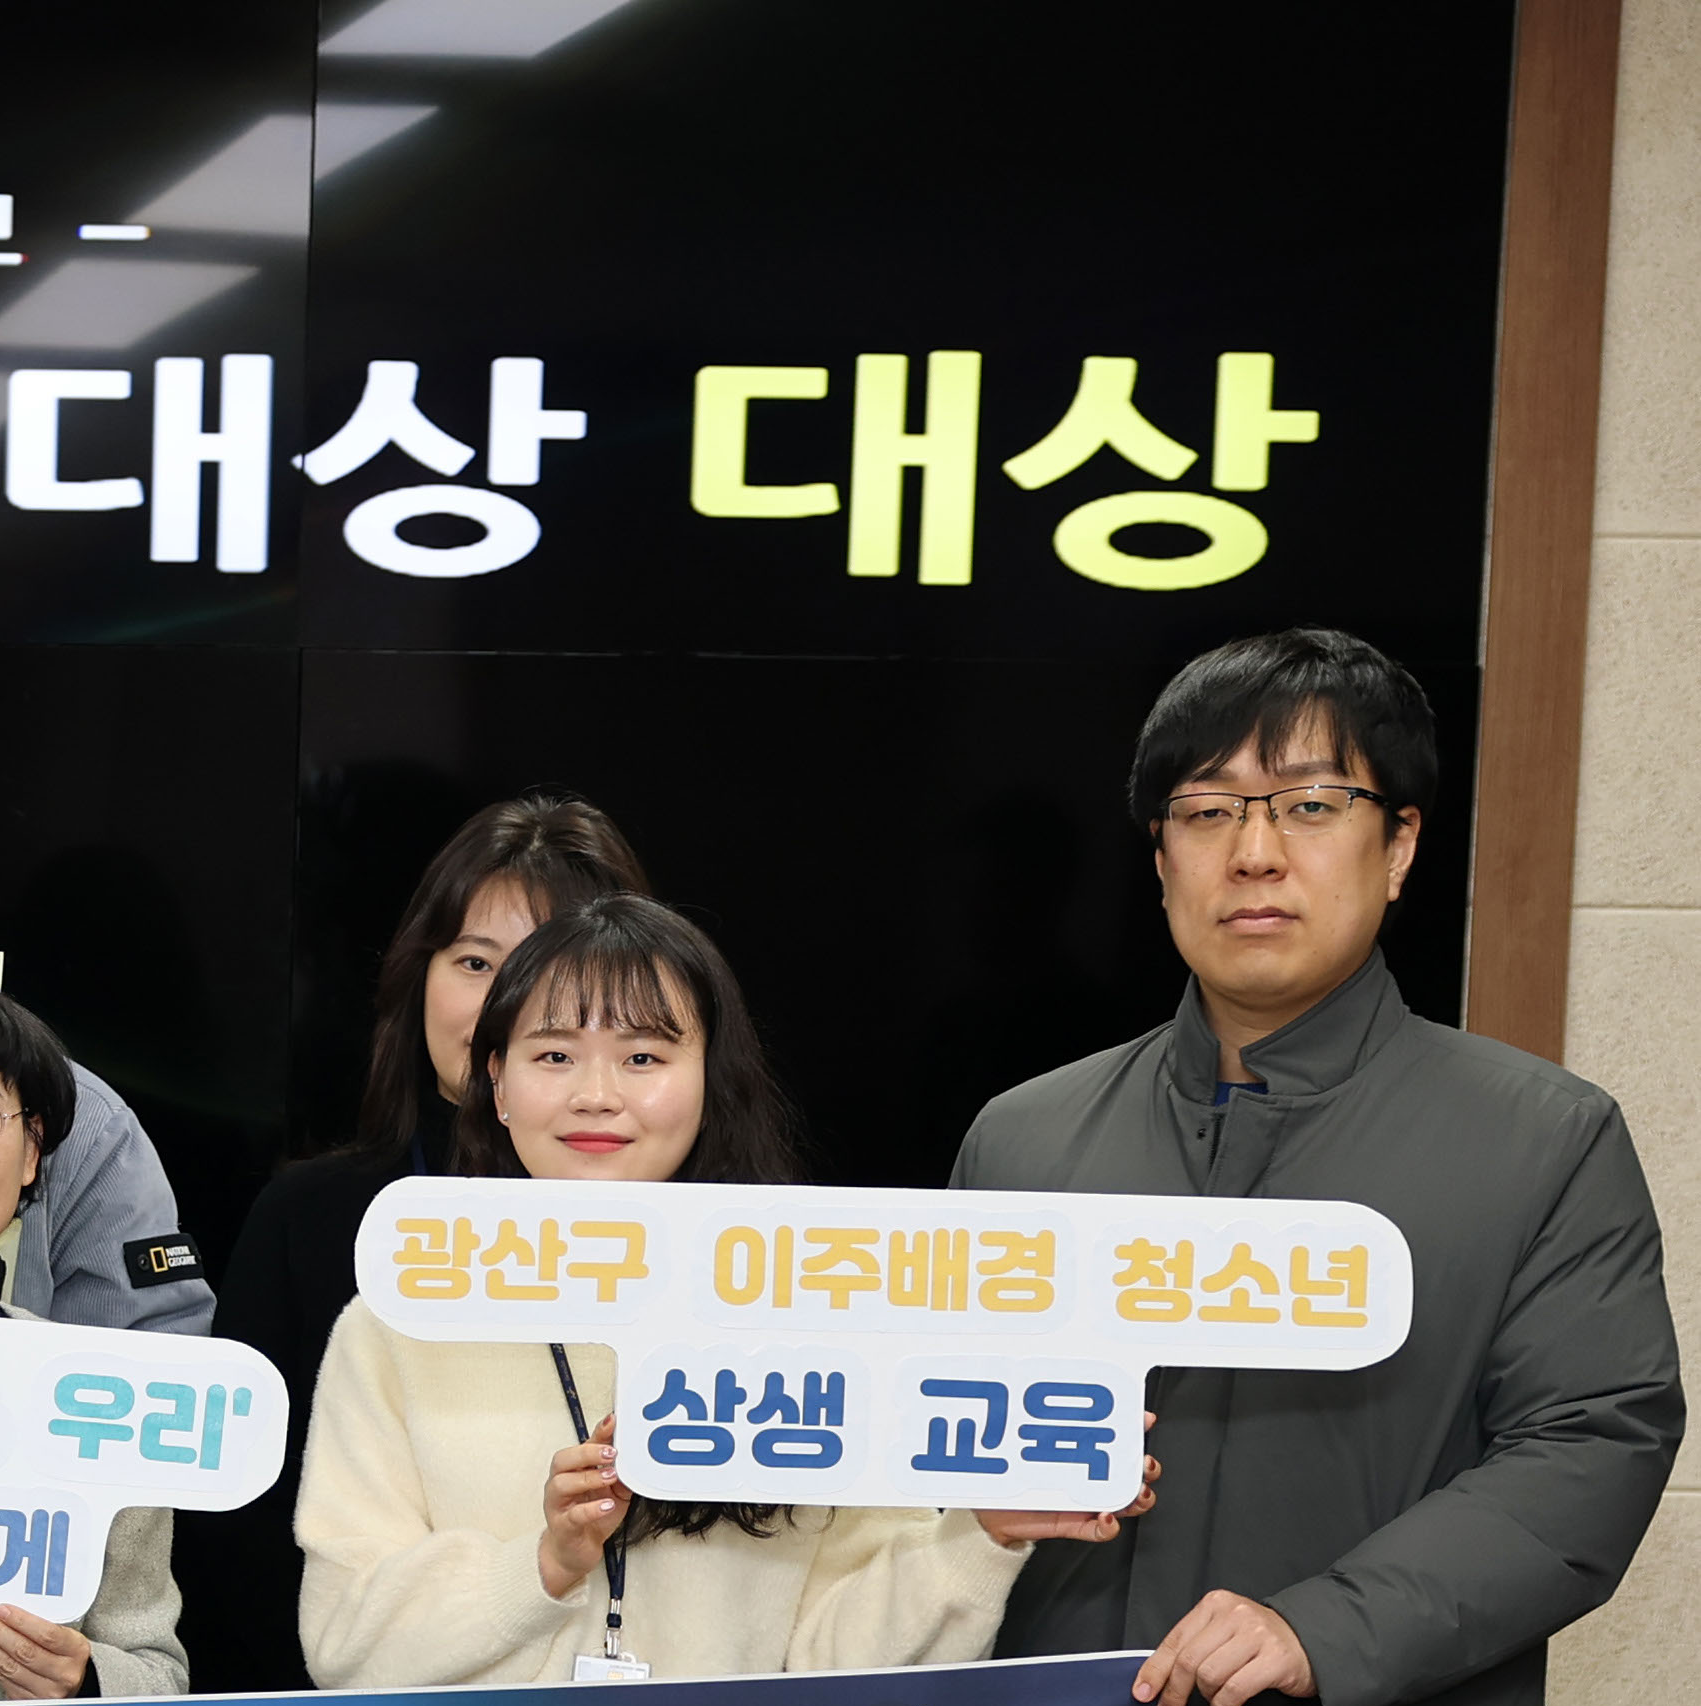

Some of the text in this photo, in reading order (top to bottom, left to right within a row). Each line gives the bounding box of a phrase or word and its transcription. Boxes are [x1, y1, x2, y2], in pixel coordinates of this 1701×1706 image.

[690, 350, 1320, 591] 대상
[392, 1216, 1369, 1329] 광산구 이주배경 청소년
[642, 1367, 846, 1470] 상생
[910, 1377, 1118, 1482] 교육
